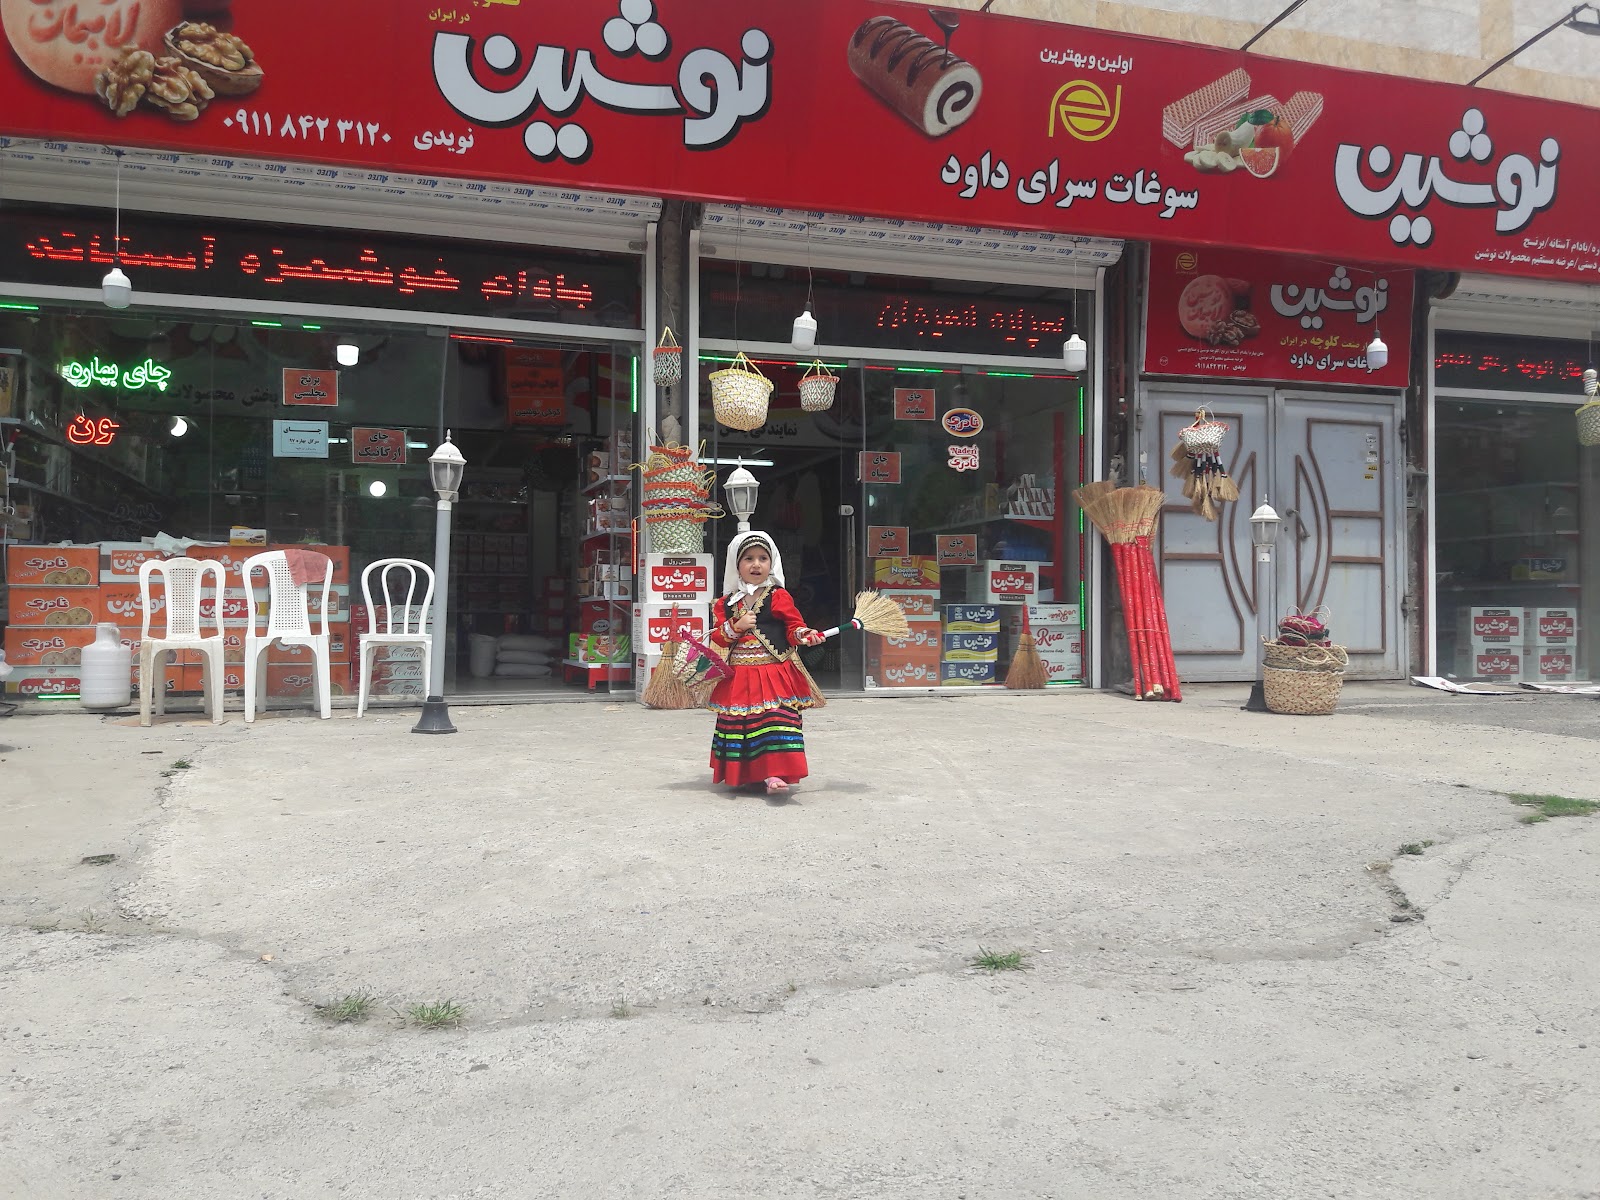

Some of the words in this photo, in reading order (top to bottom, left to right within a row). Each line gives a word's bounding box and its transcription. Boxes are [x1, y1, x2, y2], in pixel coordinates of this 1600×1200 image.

[428, 8, 457, 22] ایران
[459, 13, 471, 24] در
[1040, 48, 1087, 68] بهترین
[1087, 55, 1096, 70] و
[1097, 55, 1133, 74] اولین
[433, 0, 772, 161] نوشین
[223, 108, 273, 137] ۰۹۱۱
[280, 114, 329, 142] ۸۴۲
[336, 118, 392, 146] ۳۱۲۰
[413, 127, 475, 154] نویدی
[940, 150, 1010, 199] داود
[1334, 108, 1560, 245] نوشین
[1016, 158, 1097, 208] سرای
[1104, 167, 1199, 218] سوغات
[1474, 248, 1497, 261] نوشین
[1270, 266, 1389, 329] نوشین
[1280, 335, 1298, 346] ایران
[1299, 337, 1308, 347] در
[1310, 336, 1340, 350] کلوچه
[1341, 341, 1360, 349] صنعت
[1290, 352, 1314, 369] داود
[1316, 354, 1344, 371] سرای
[69, 357, 118, 388] بهاره
[123, 359, 171, 391] چای
[300, 374, 320, 386] برنج
[294, 388, 327, 400] مجلسی
[905, 405, 925, 417] سفید
[946, 415, 980, 430] نادری
[951, 445, 977, 455] Naderi
[950, 455, 977, 469] نادری
[871, 468, 889, 480] سیاه
[878, 545, 899, 555] سبز
[25, 557, 68, 570] نادری
[653, 569, 695, 589] نوشین
[992, 574, 1025, 591] نوشین
[26, 597, 69, 611] نادری
[966, 606, 995, 621] نوشین
[1475, 619, 1509, 634] نوشین
[1540, 620, 1566, 634] نوشین
[22, 637, 66, 651] نادری
[963, 634, 992, 650] نوشین
[960, 663, 989, 678] نوشین
[1478, 657, 1510, 673] نوشین
[1541, 657, 1565, 672] نوشین
[885, 662, 927, 683] نوشین
